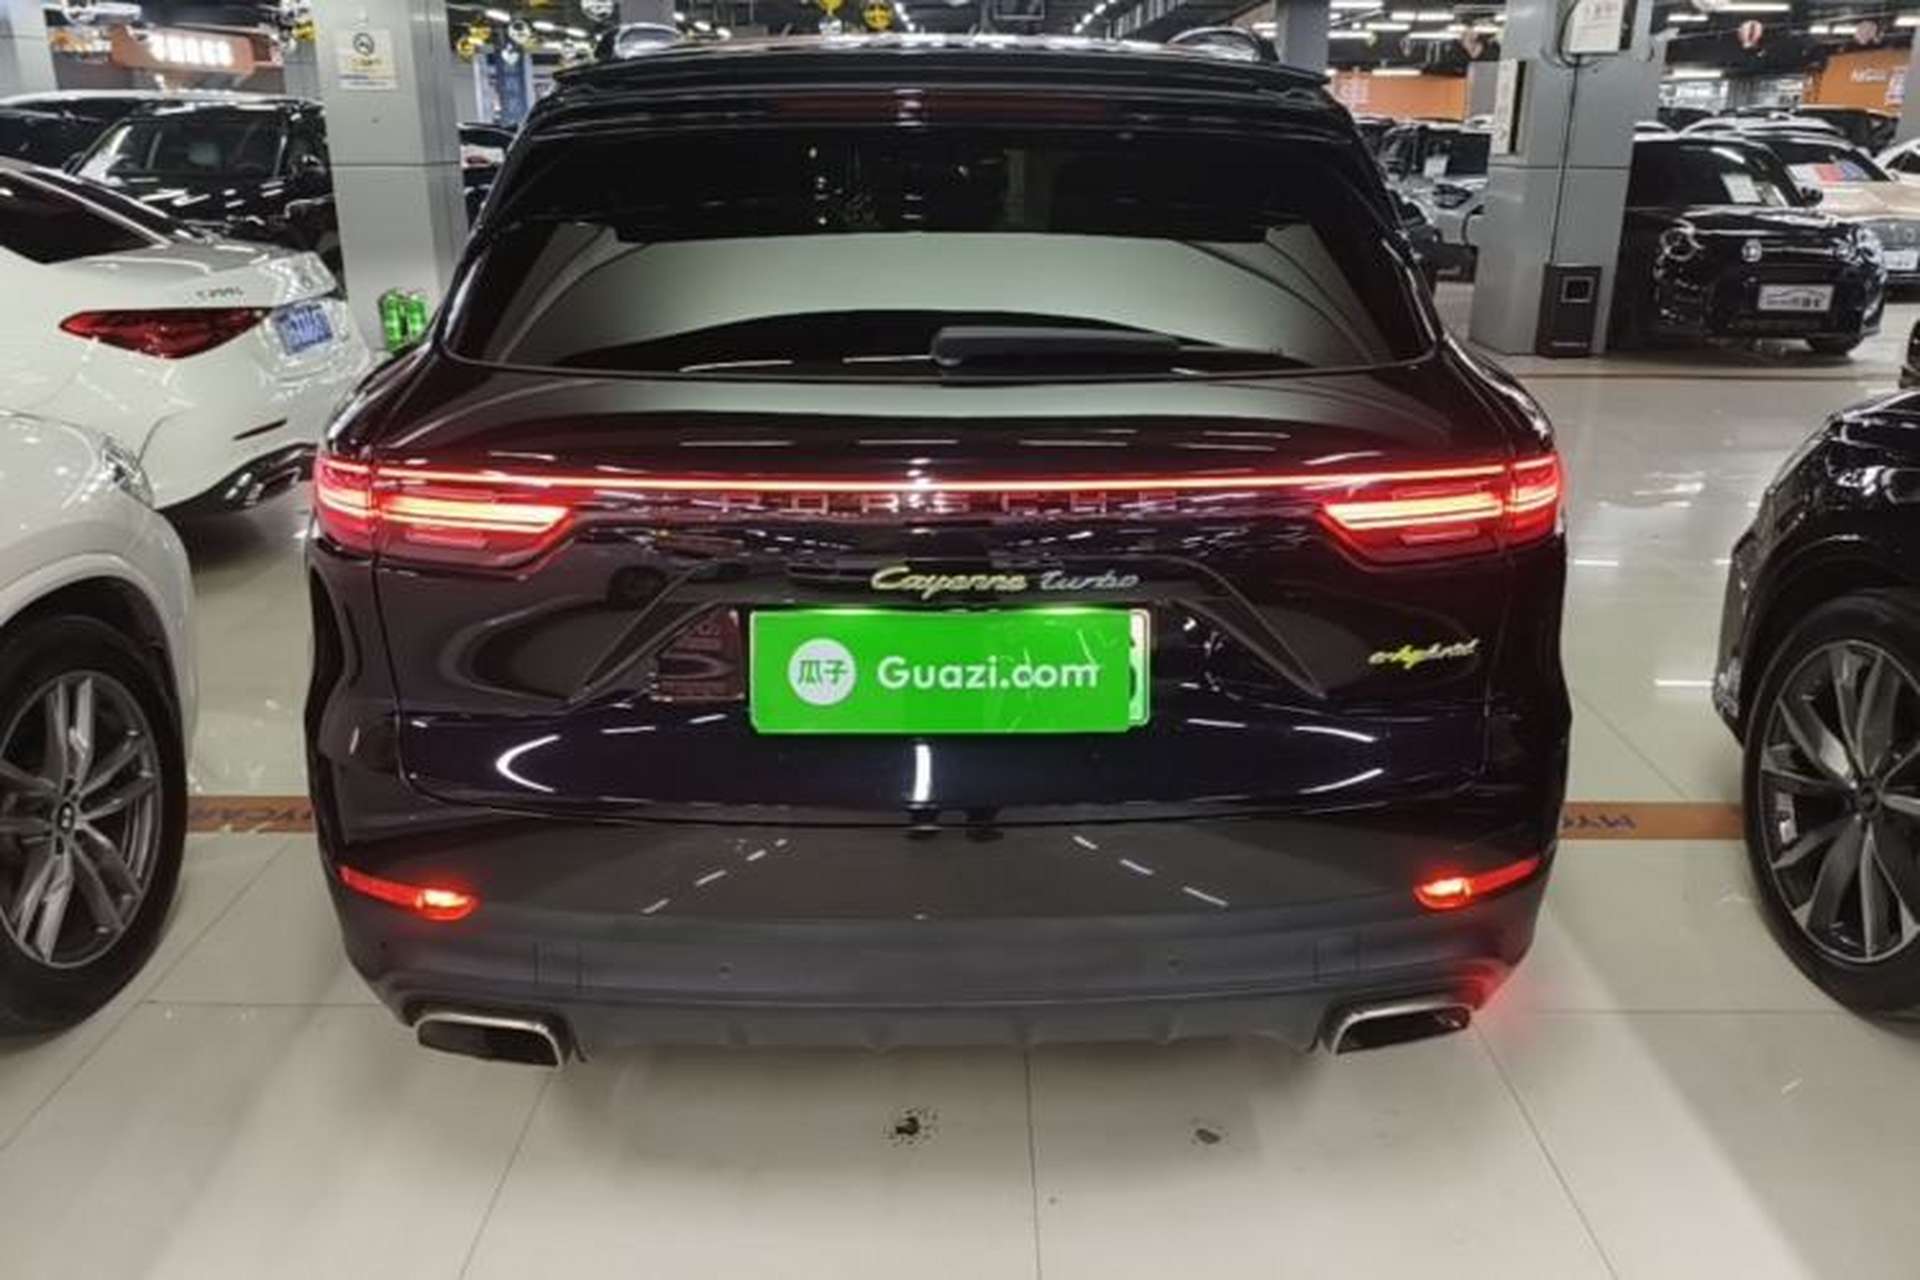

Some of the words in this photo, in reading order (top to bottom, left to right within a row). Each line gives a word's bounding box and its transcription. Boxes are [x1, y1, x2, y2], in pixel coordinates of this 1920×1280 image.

[871, 562, 1028, 600] Cayenne
[1039, 569, 1142, 591] turbo
[796, 658, 848, 686] 瓜子
[877, 655, 1100, 691] Guazi.com
